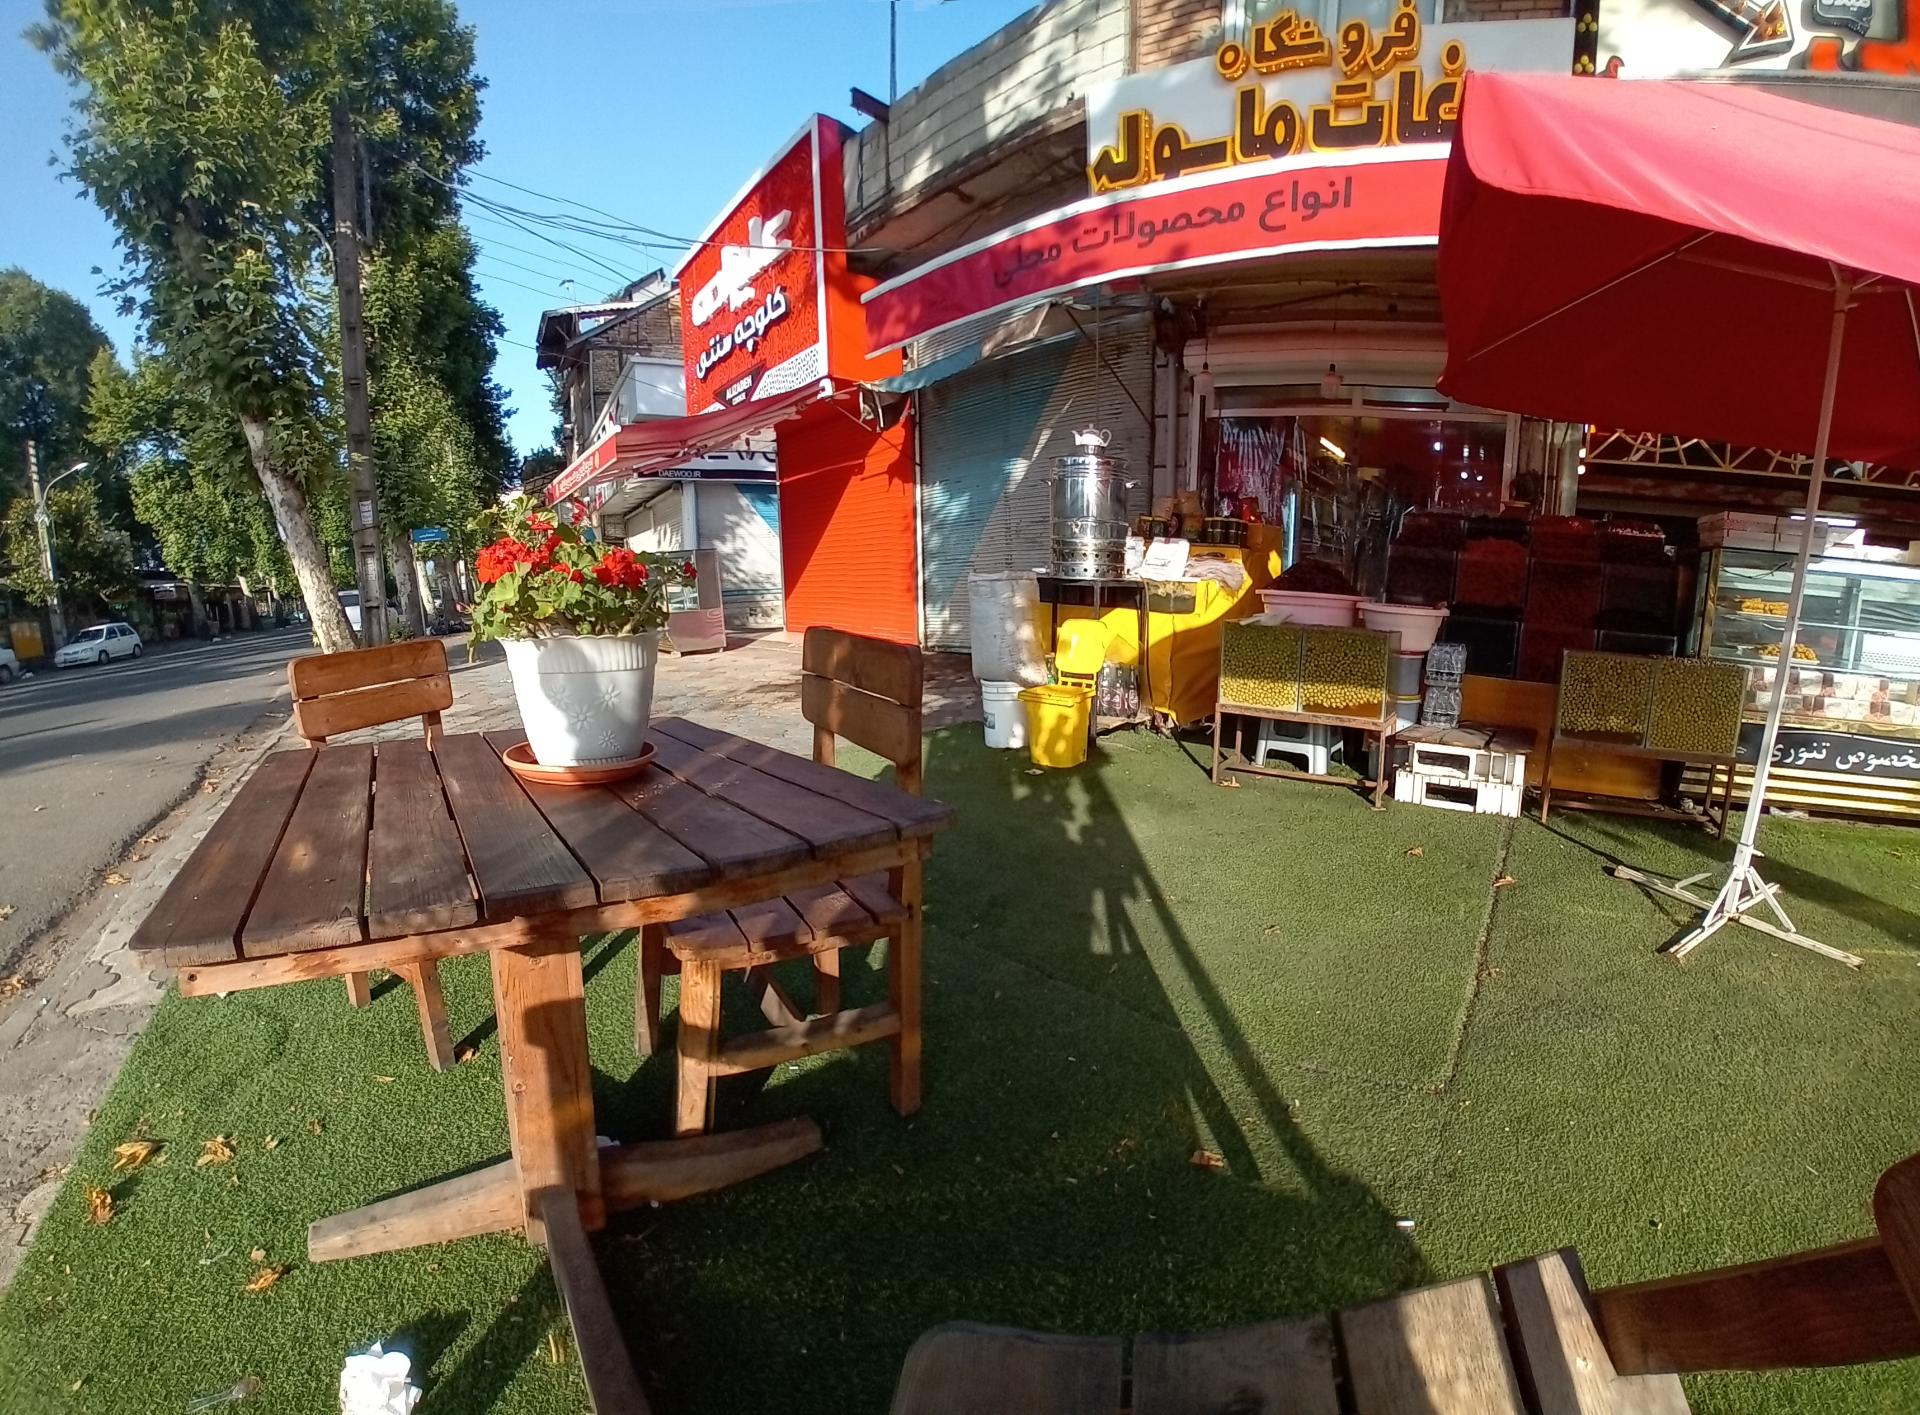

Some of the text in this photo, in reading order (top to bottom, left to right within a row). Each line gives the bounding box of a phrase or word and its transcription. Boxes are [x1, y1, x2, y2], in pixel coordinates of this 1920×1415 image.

[993, 174, 1353, 289] انواع محصولات محلی
[734, 285, 787, 353] کلوچه
[658, 470, 701, 478] DAEWOO.IR
[1770, 741, 1920, 772] خصوص تنوری
